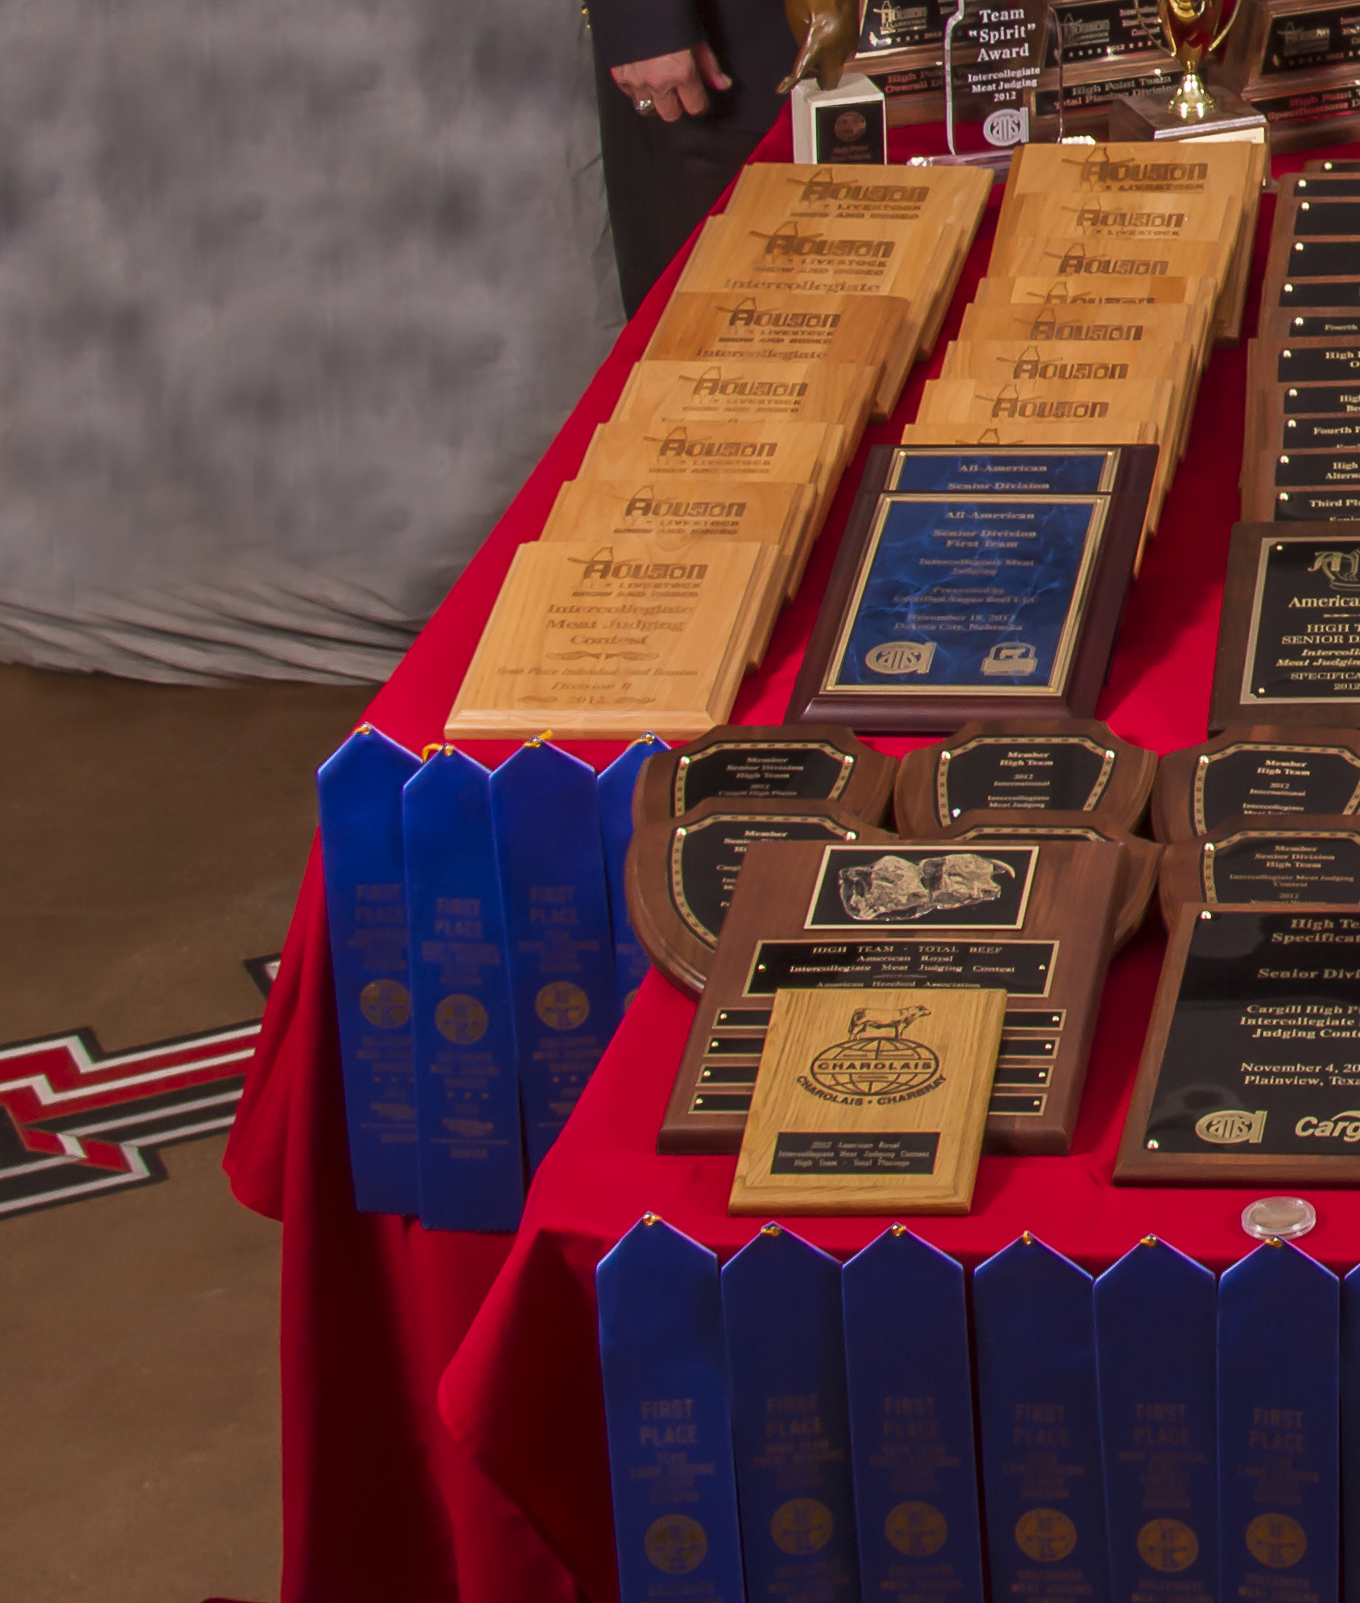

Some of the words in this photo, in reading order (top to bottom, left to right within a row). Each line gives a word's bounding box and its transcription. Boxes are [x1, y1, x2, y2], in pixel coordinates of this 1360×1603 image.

[980, 7, 1025, 23] Team
[978, 43, 1029, 62] Award
[967, 66, 1040, 83] Intercollegiate
[972, 80, 1001, 93] Meat
[1003, 77, 1038, 92] Judging
[994, 90, 1016, 102] 2012
[1326, 351, 1354, 360] High
[1308, 624, 1349, 632] HIGH
[1282, 635, 1343, 644] SENIOR
[1291, 919, 1334, 930] High
[818, 1061, 932, 1071] CHAROLAIS
[641, 1400, 693, 1420] FIRST
[639, 1424, 697, 1448] PLACE
